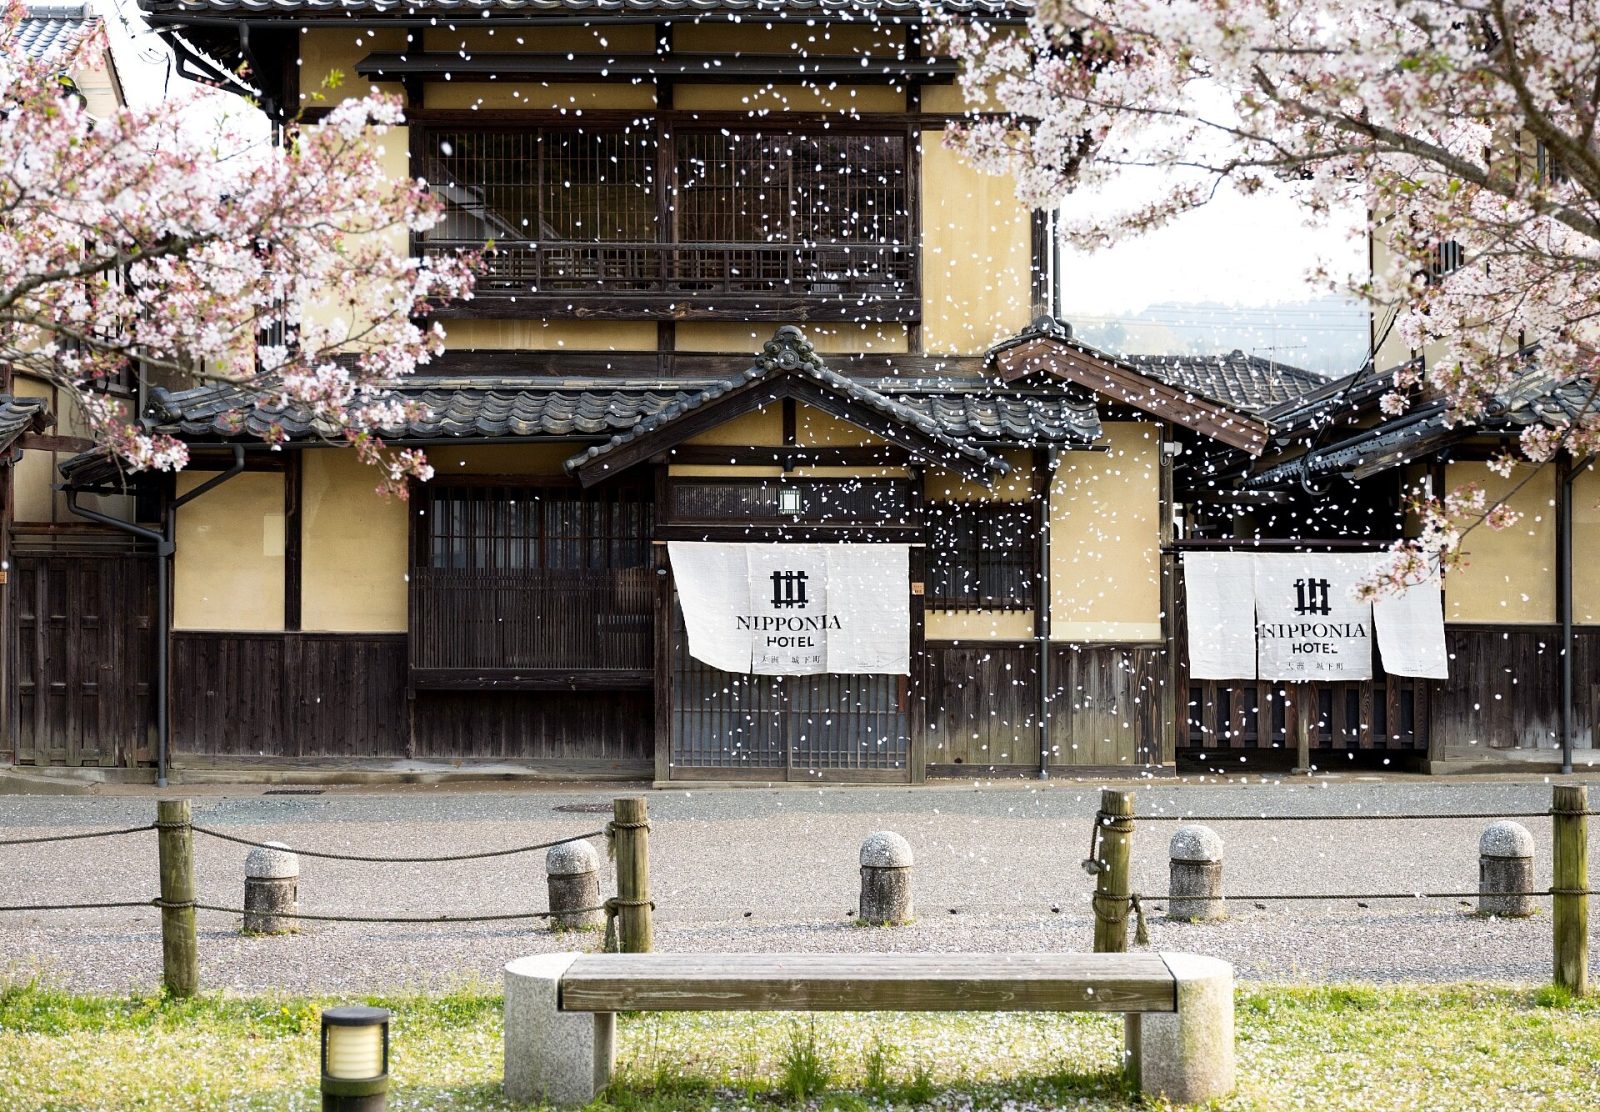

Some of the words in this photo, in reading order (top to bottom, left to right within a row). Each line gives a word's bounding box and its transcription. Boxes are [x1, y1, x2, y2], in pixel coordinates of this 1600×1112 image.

[736, 614, 842, 632] NIPPONIA
[1261, 623, 1367, 638] NIPPONIA
[766, 636, 815, 648] HOTEL
[1292, 642, 1338, 654] HOTEL
